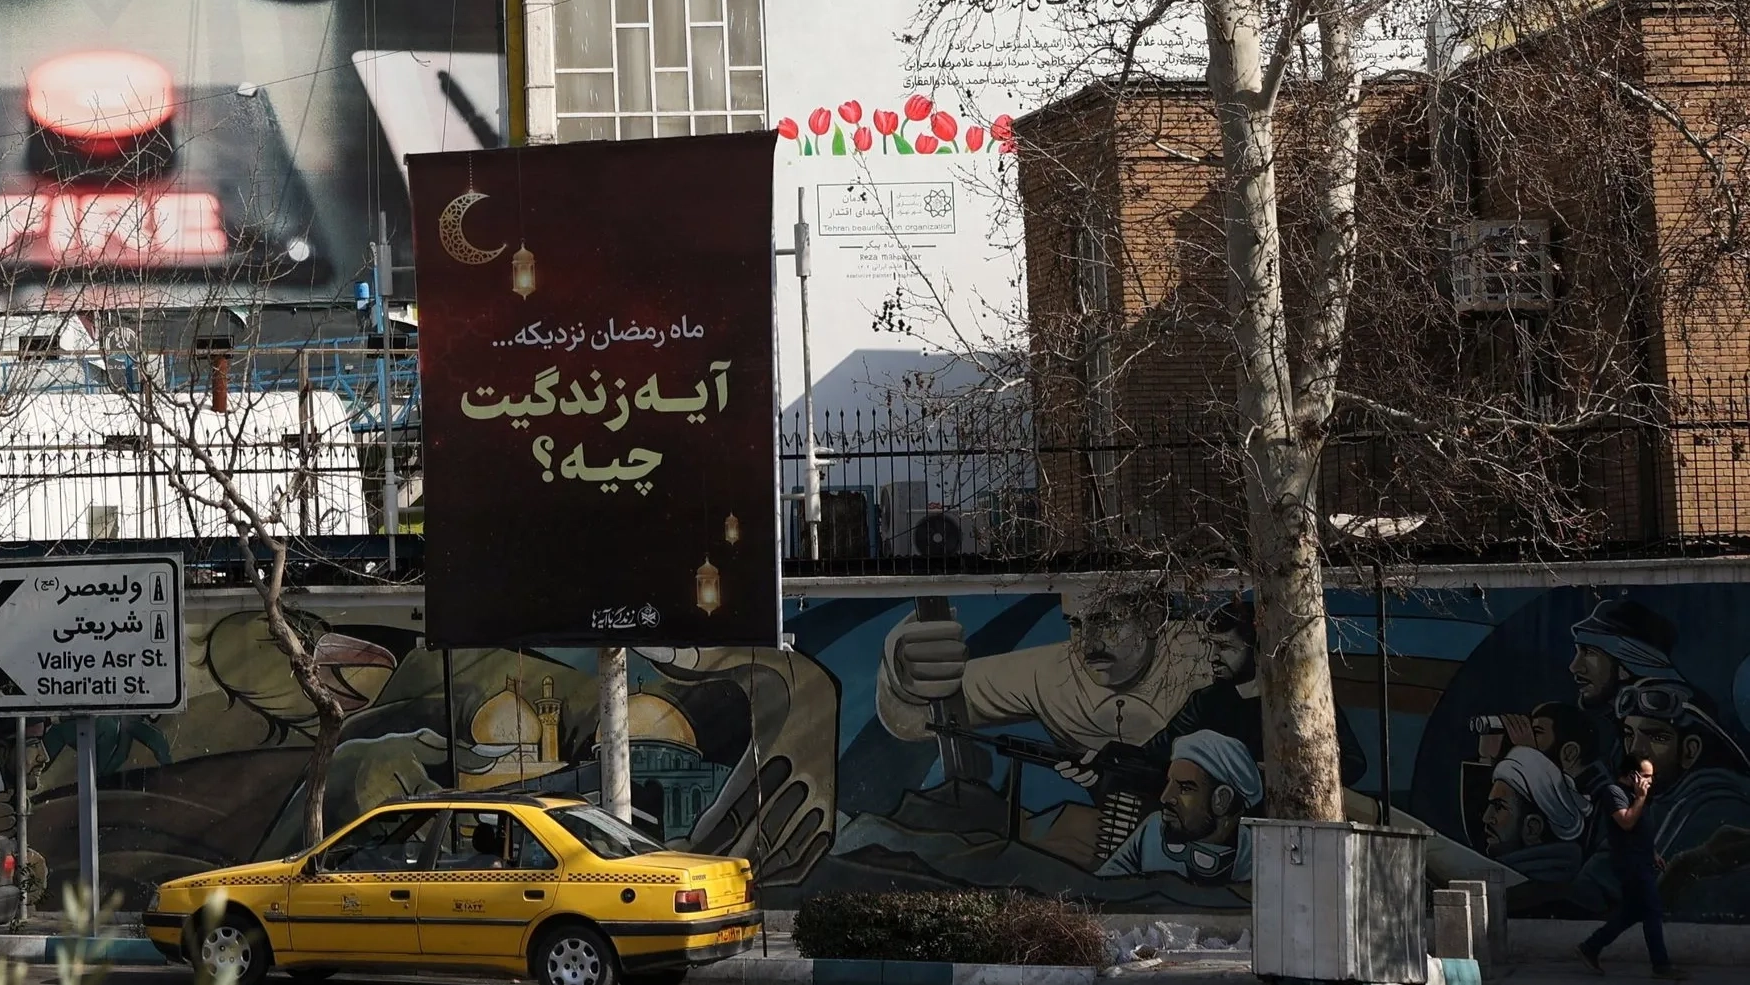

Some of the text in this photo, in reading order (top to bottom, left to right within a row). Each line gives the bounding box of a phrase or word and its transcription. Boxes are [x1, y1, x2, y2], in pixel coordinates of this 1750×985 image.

[492, 315, 704, 352] ماه رمضان نزدیکه...
[460, 366, 630, 432] زندگیت
[532, 435, 664, 496] چیه؟
[57, 574, 143, 606] ولیعصر
[53, 610, 143, 643] شریعتی
[37, 649, 168, 673] Valiye Asr St.
[37, 676, 150, 696] Shari'ati St.
